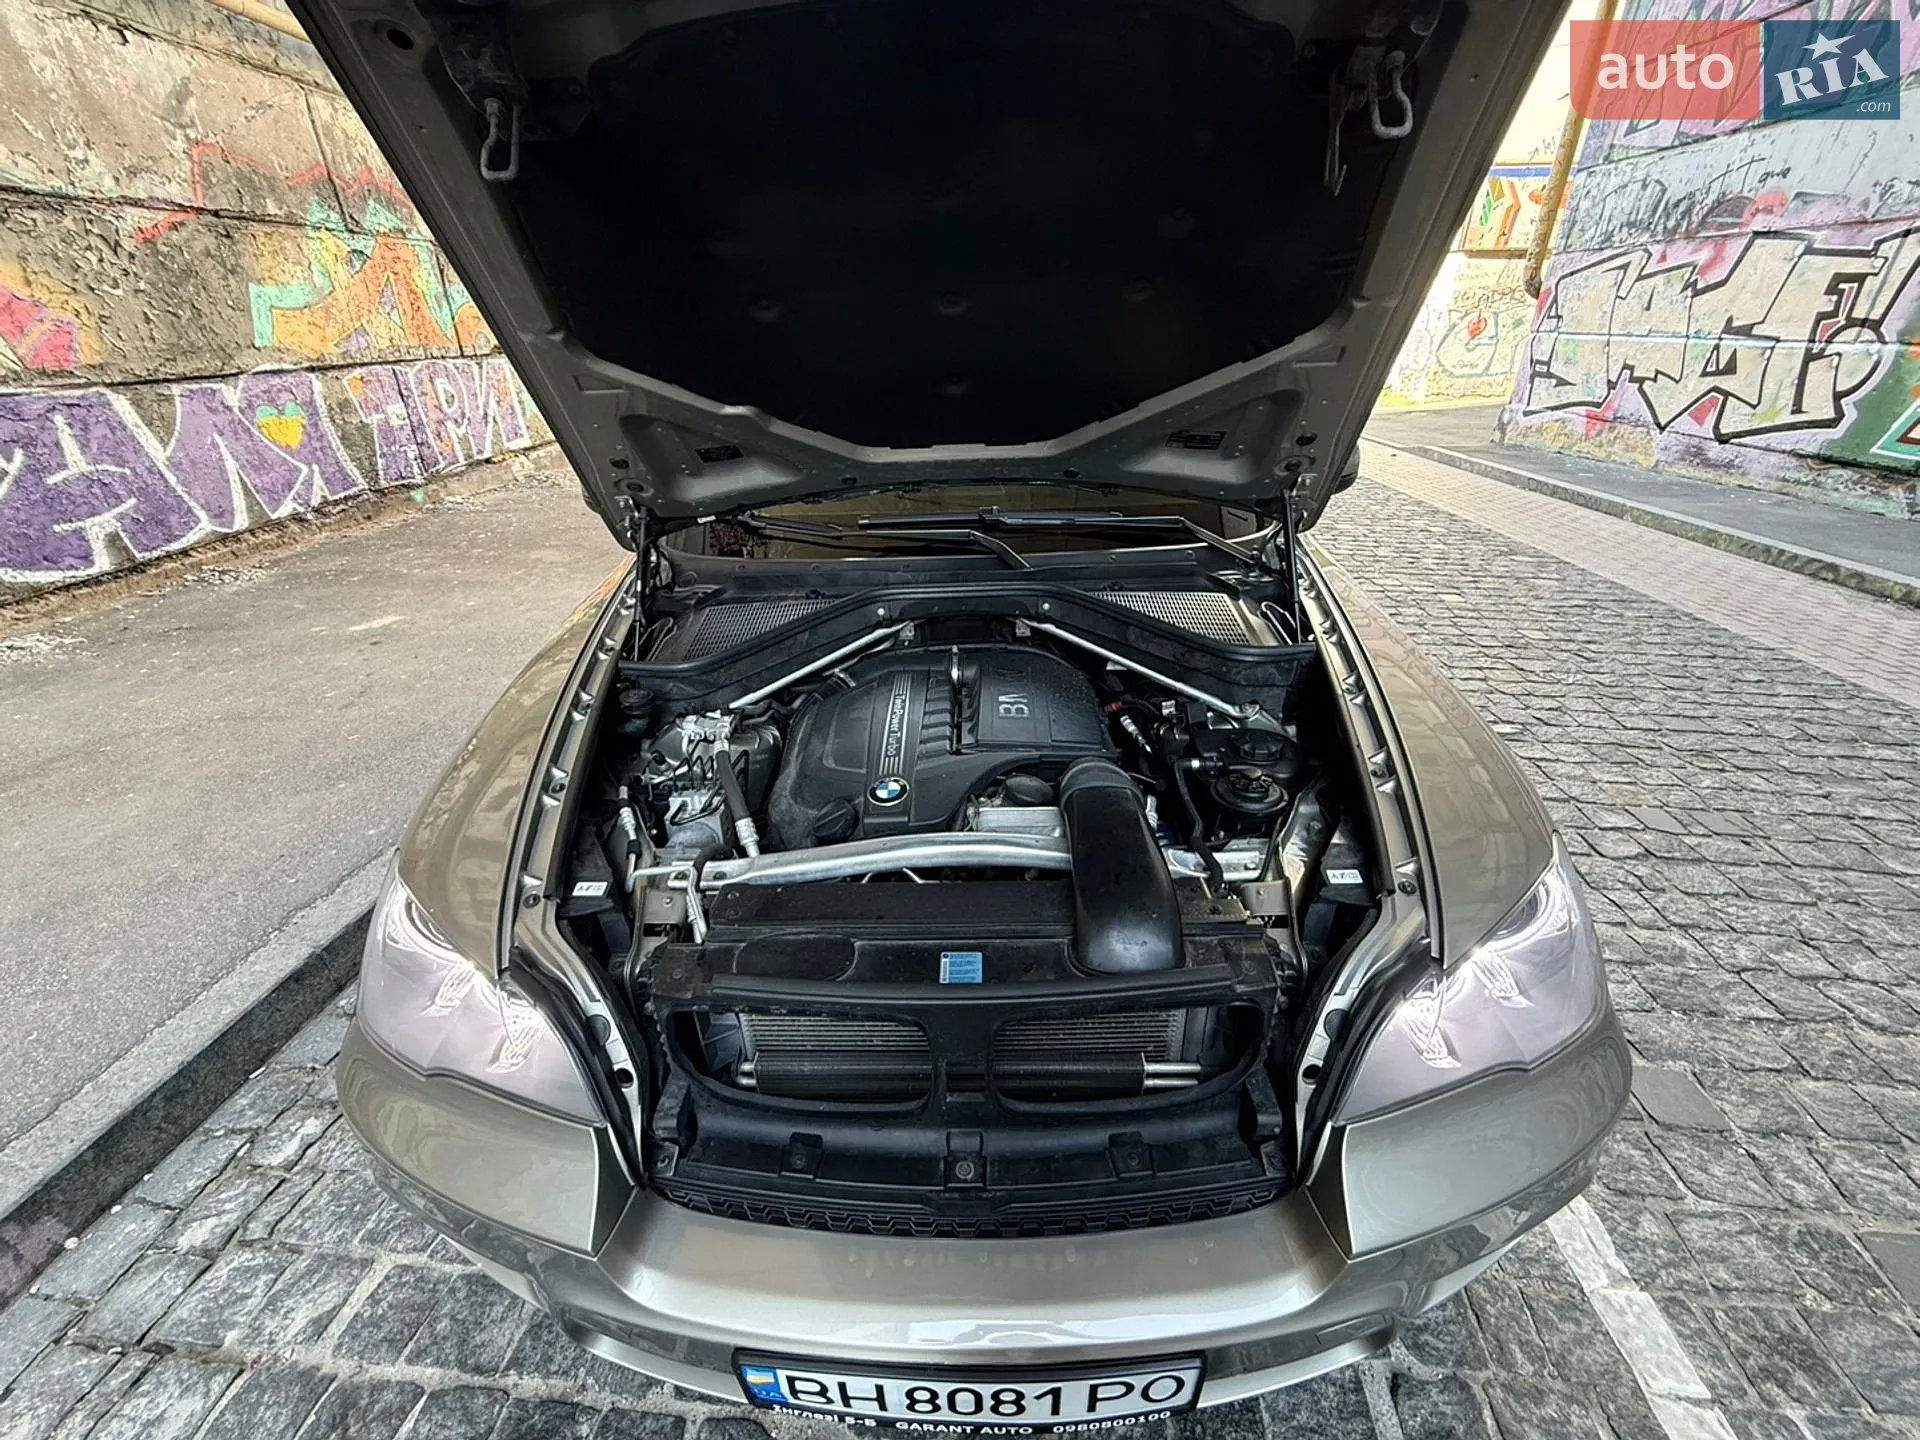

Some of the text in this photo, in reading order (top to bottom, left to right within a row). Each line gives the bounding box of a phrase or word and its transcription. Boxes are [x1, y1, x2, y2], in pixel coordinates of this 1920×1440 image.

[904, 1385, 1062, 1417] 8081
[895, 1421, 1033, 1435] GARANT AUTO
